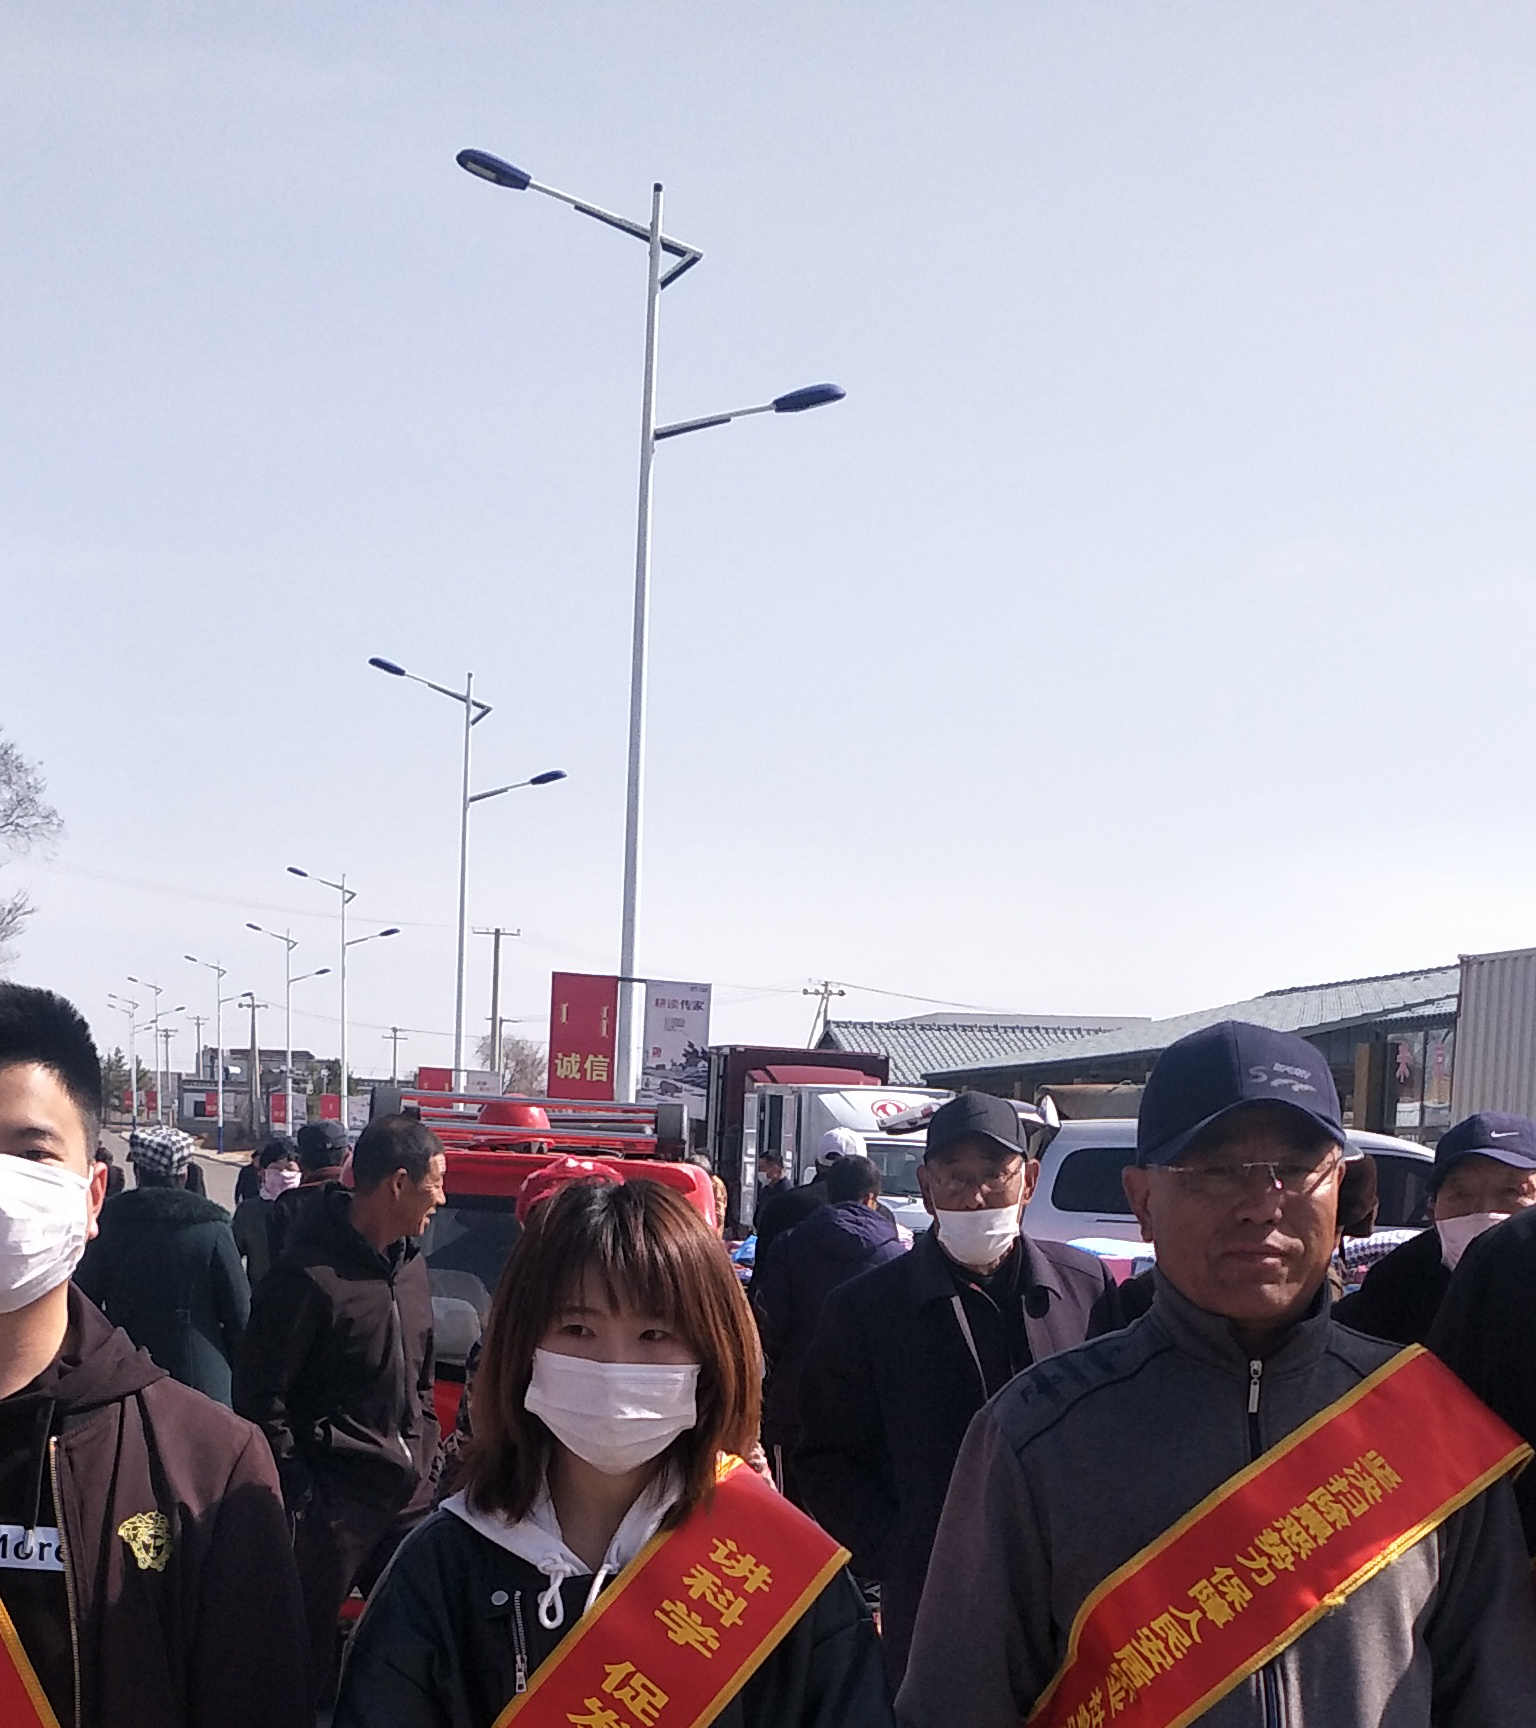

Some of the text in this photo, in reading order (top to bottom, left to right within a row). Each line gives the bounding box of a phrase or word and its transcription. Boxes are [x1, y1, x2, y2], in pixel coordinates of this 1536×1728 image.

[554, 1052, 611, 1082] 诚信
[1236, 1449, 1403, 1587] 坚决扫除黑恶势力
[655, 1538, 774, 1658] 讲科学
